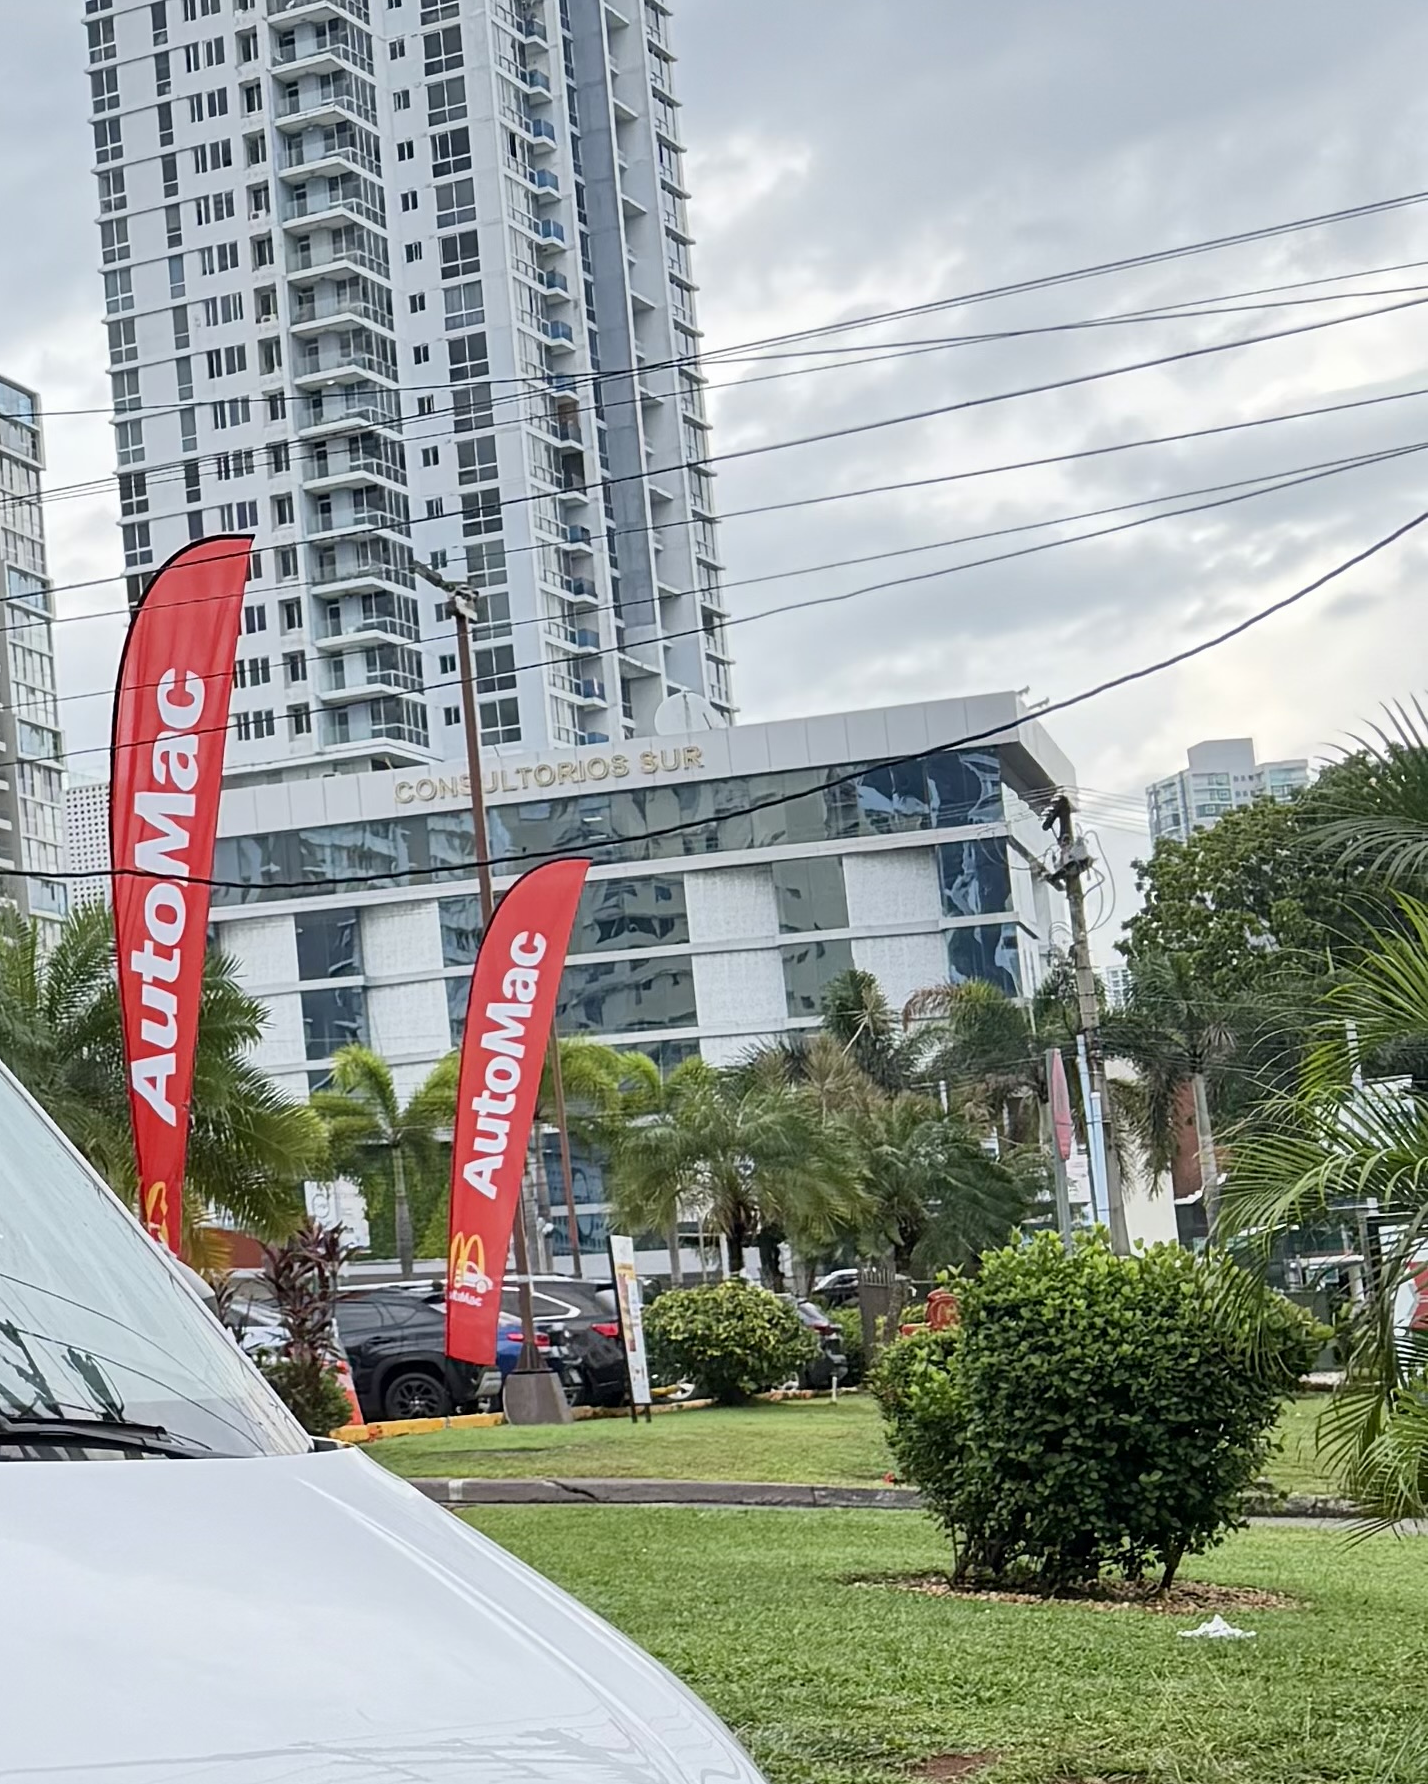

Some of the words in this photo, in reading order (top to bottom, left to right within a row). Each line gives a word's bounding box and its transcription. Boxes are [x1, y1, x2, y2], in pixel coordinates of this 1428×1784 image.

[130, 667, 206, 1128] AutoMac
[395, 755, 630, 804] CONSULTORIOS
[640, 746, 704, 774] SUR
[462, 930, 547, 1200] AutoMac
